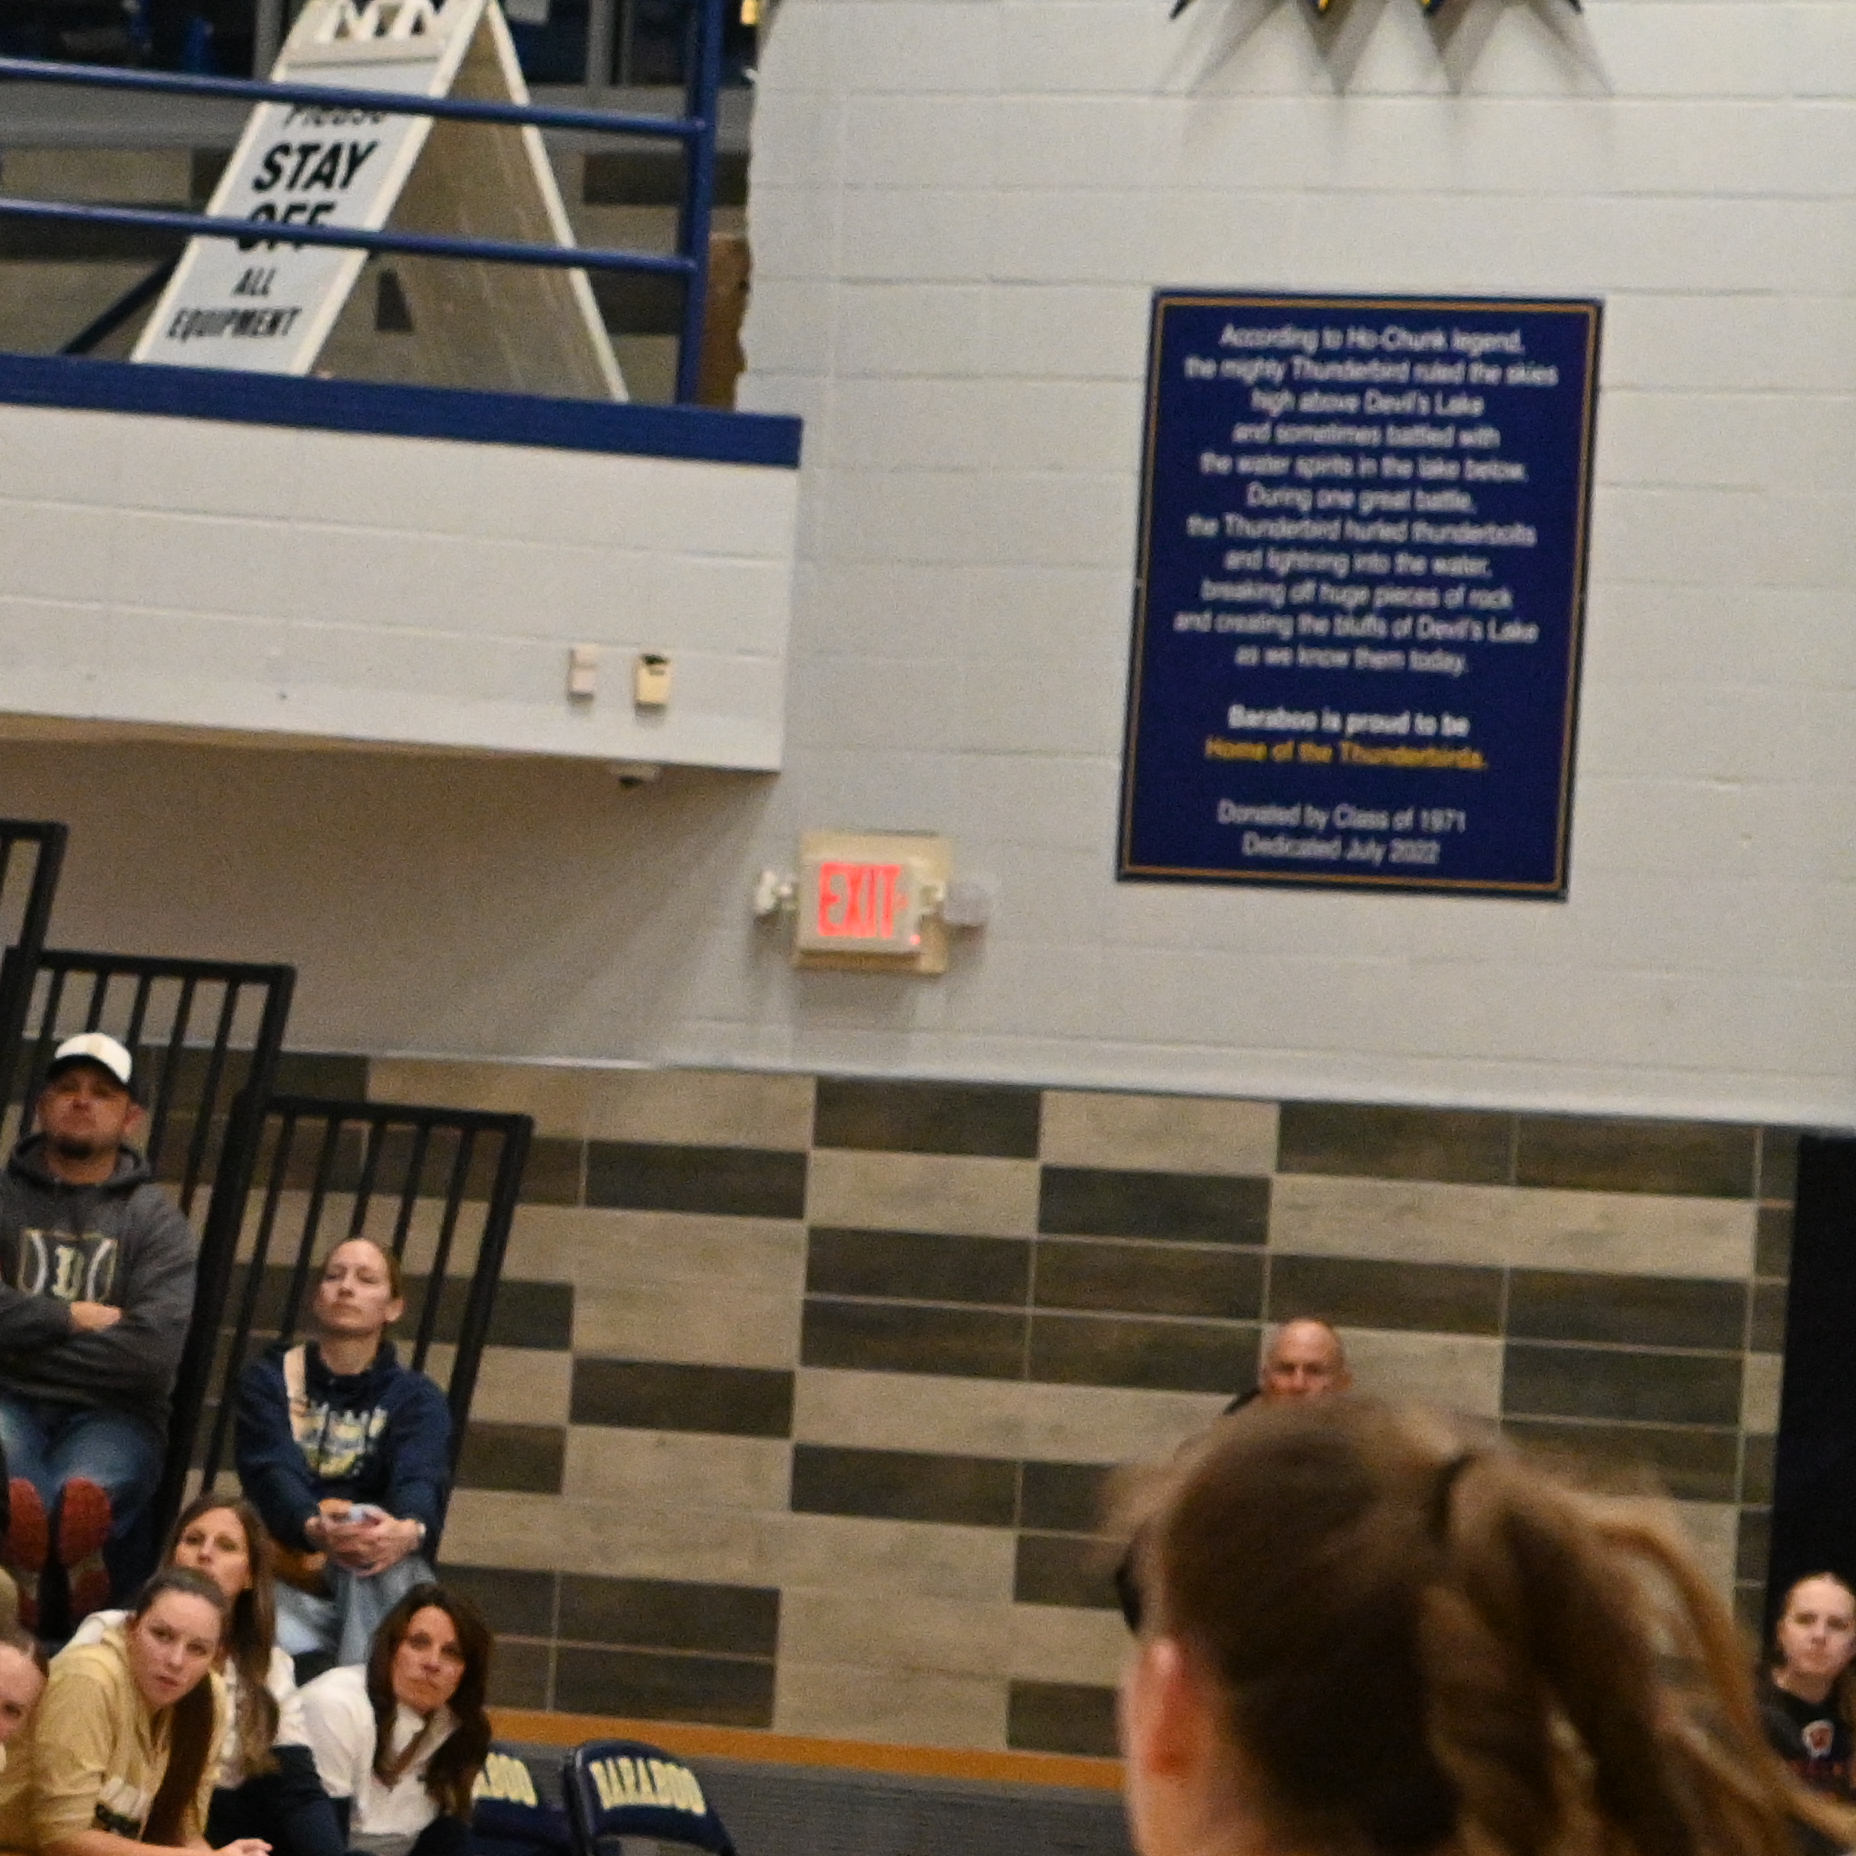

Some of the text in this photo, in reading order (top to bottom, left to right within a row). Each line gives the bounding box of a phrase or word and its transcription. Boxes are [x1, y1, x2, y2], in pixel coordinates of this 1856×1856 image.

[252, 140, 379, 192] STAY
[233, 267, 277, 297] ALL
[166, 306, 303, 343] EQUIPMENT
[1445, 586, 1464, 607] of
[1393, 616, 1412, 638] of
[1206, 739, 1267, 761] Home
[1272, 740, 1294, 761] of
[1394, 810, 1413, 829] of
[1422, 810, 1465, 832] 1971
[817, 861, 902, 939] EXIT
